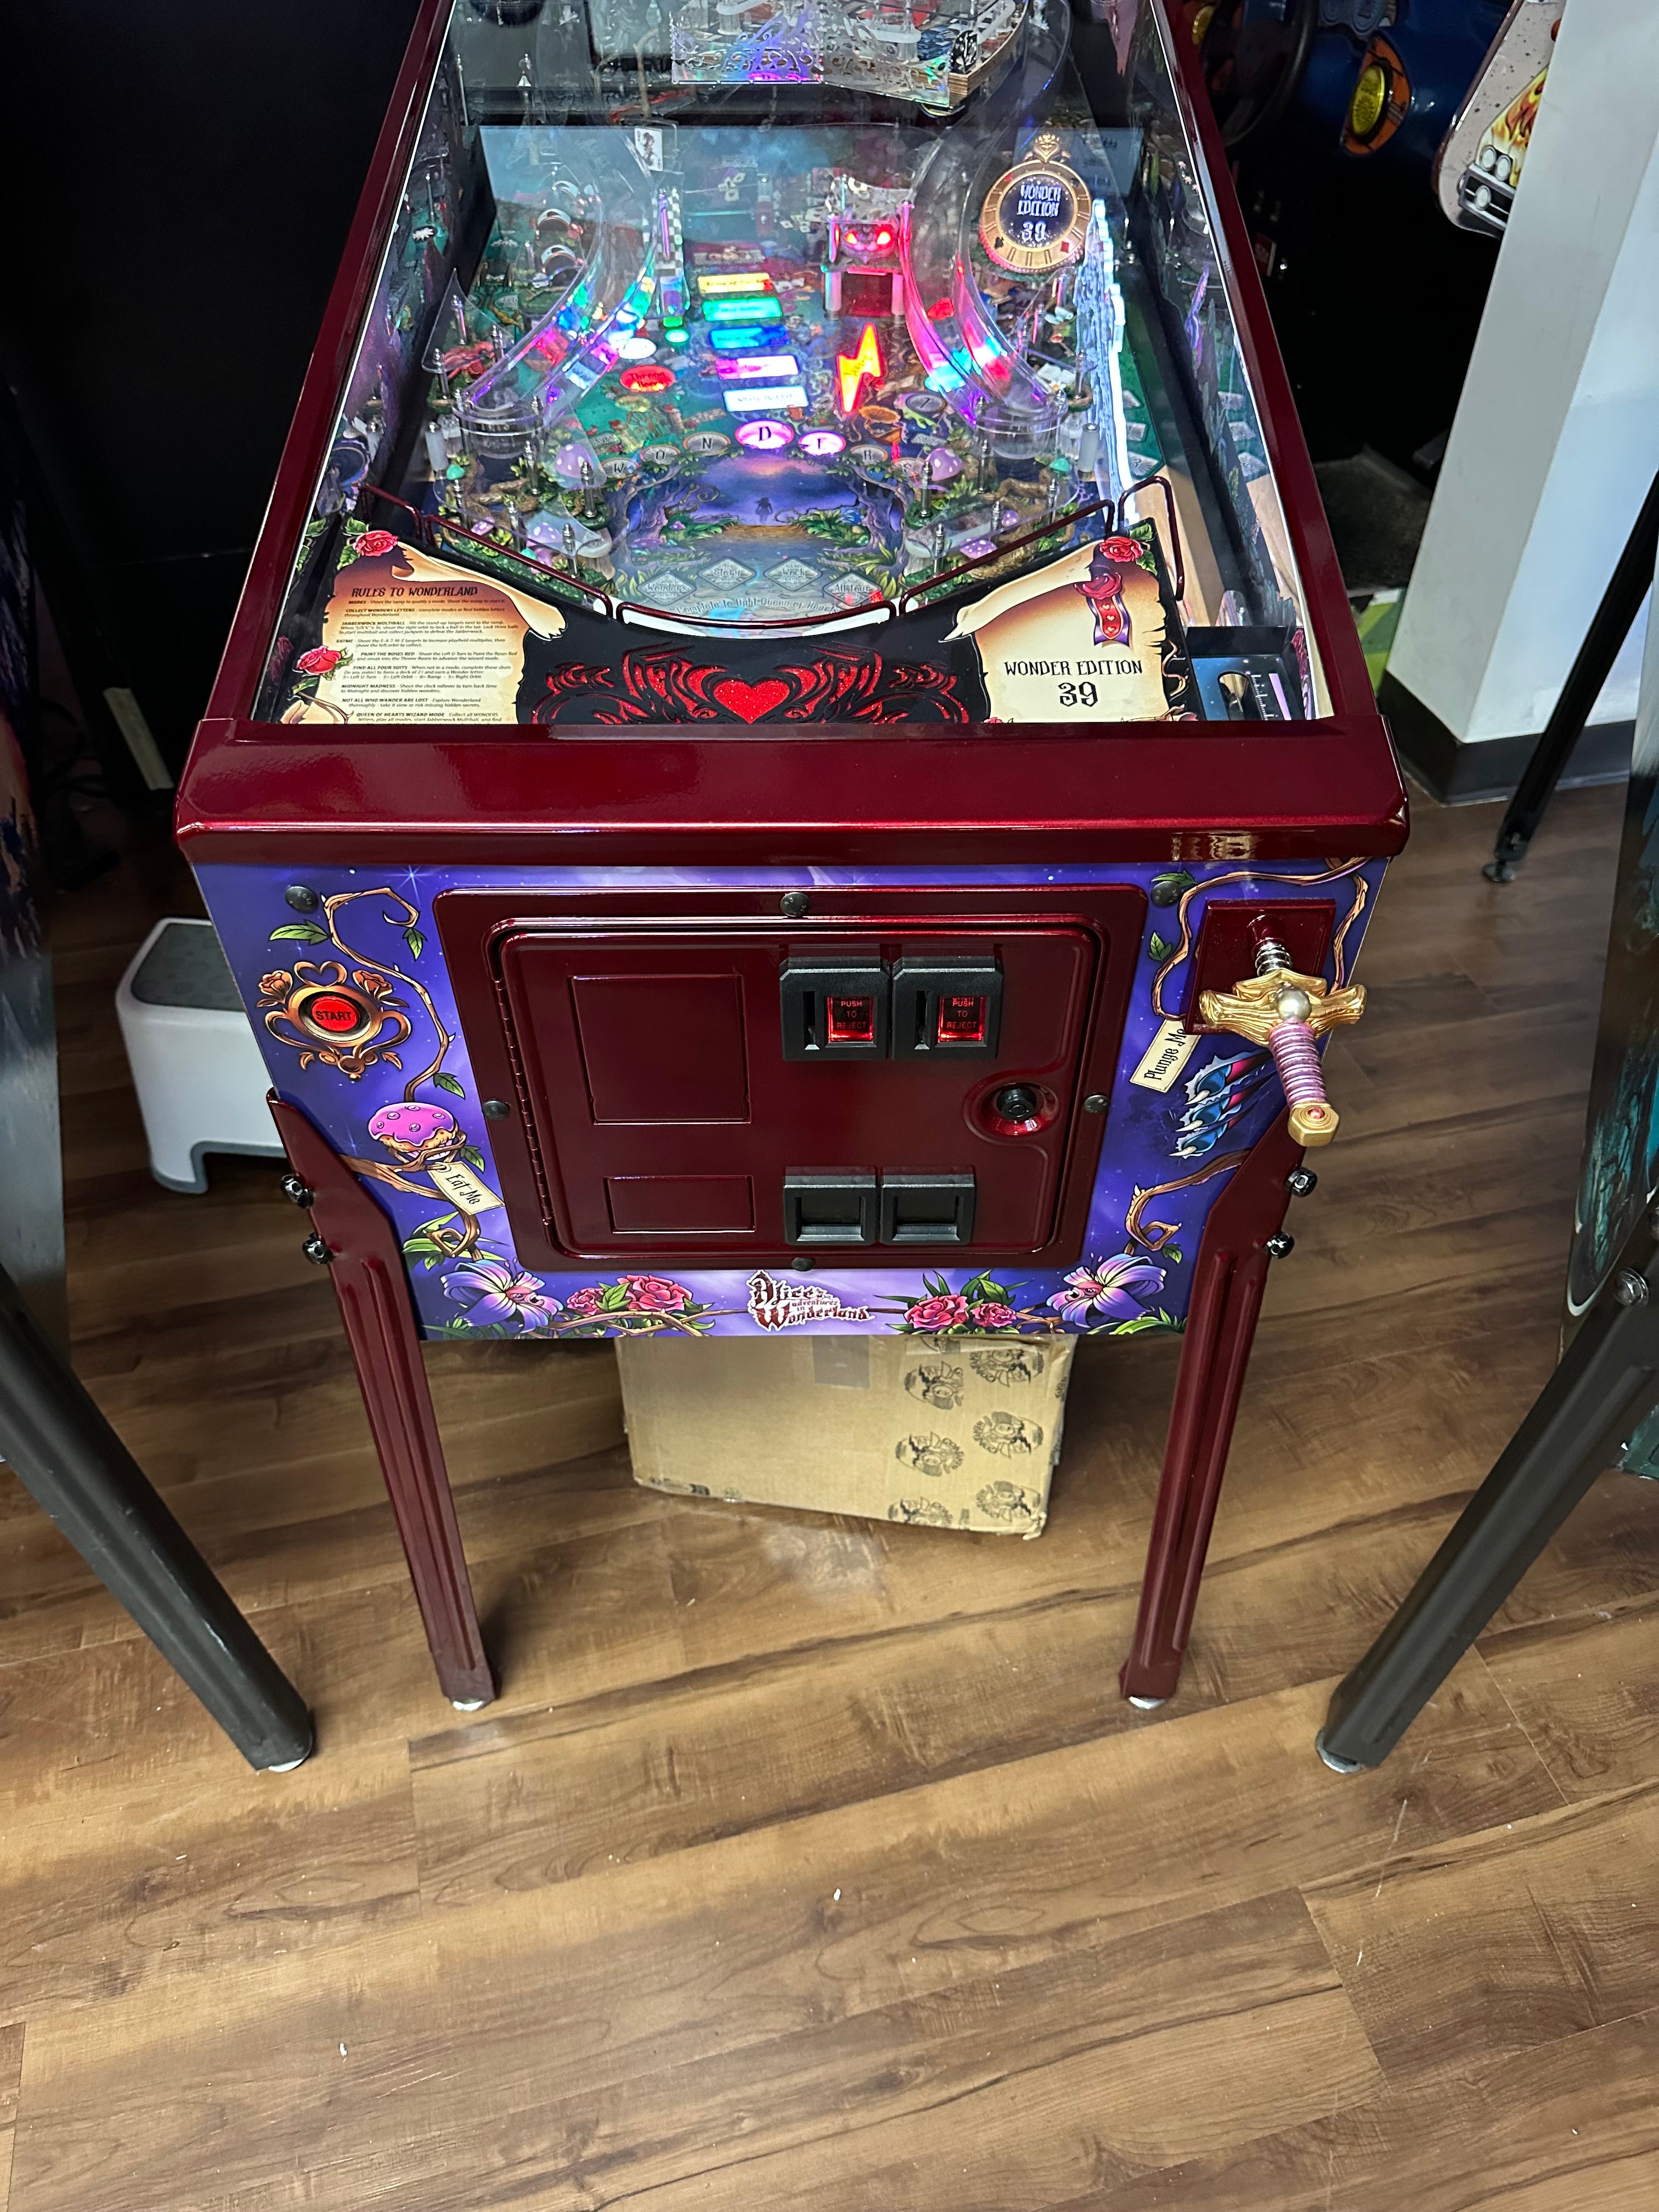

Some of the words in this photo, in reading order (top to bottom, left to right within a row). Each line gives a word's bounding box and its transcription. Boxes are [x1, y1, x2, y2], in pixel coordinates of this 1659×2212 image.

[1016, 200, 1060, 217] EDITION
[1021, 220, 1047, 242] 39
[614, 463, 624, 472] W
[656, 450, 665, 460] O
[702, 437, 712, 449] N
[759, 426, 771, 442] D
[863, 450, 872, 460] R
[714, 568, 741, 577] Story
[352, 587, 386, 597] RULES
[390, 587, 405, 597] TO
[409, 586, 478, 597] WONDERLAND
[676, 601, 720, 614] Complete
[1004, 661, 1072, 676] WONDER
[1075, 659, 1143, 676] EDITION
[1057, 681, 1098, 707] 39
[315, 1010, 352, 1021] START
[1144, 1048, 1179, 1081] Plunge
[1164, 1028, 1187, 1047] Me
[445, 1174, 472, 1190] Eat
[460, 1189, 483, 1204] Me
[752, 1302, 870, 1329] Wonderland
